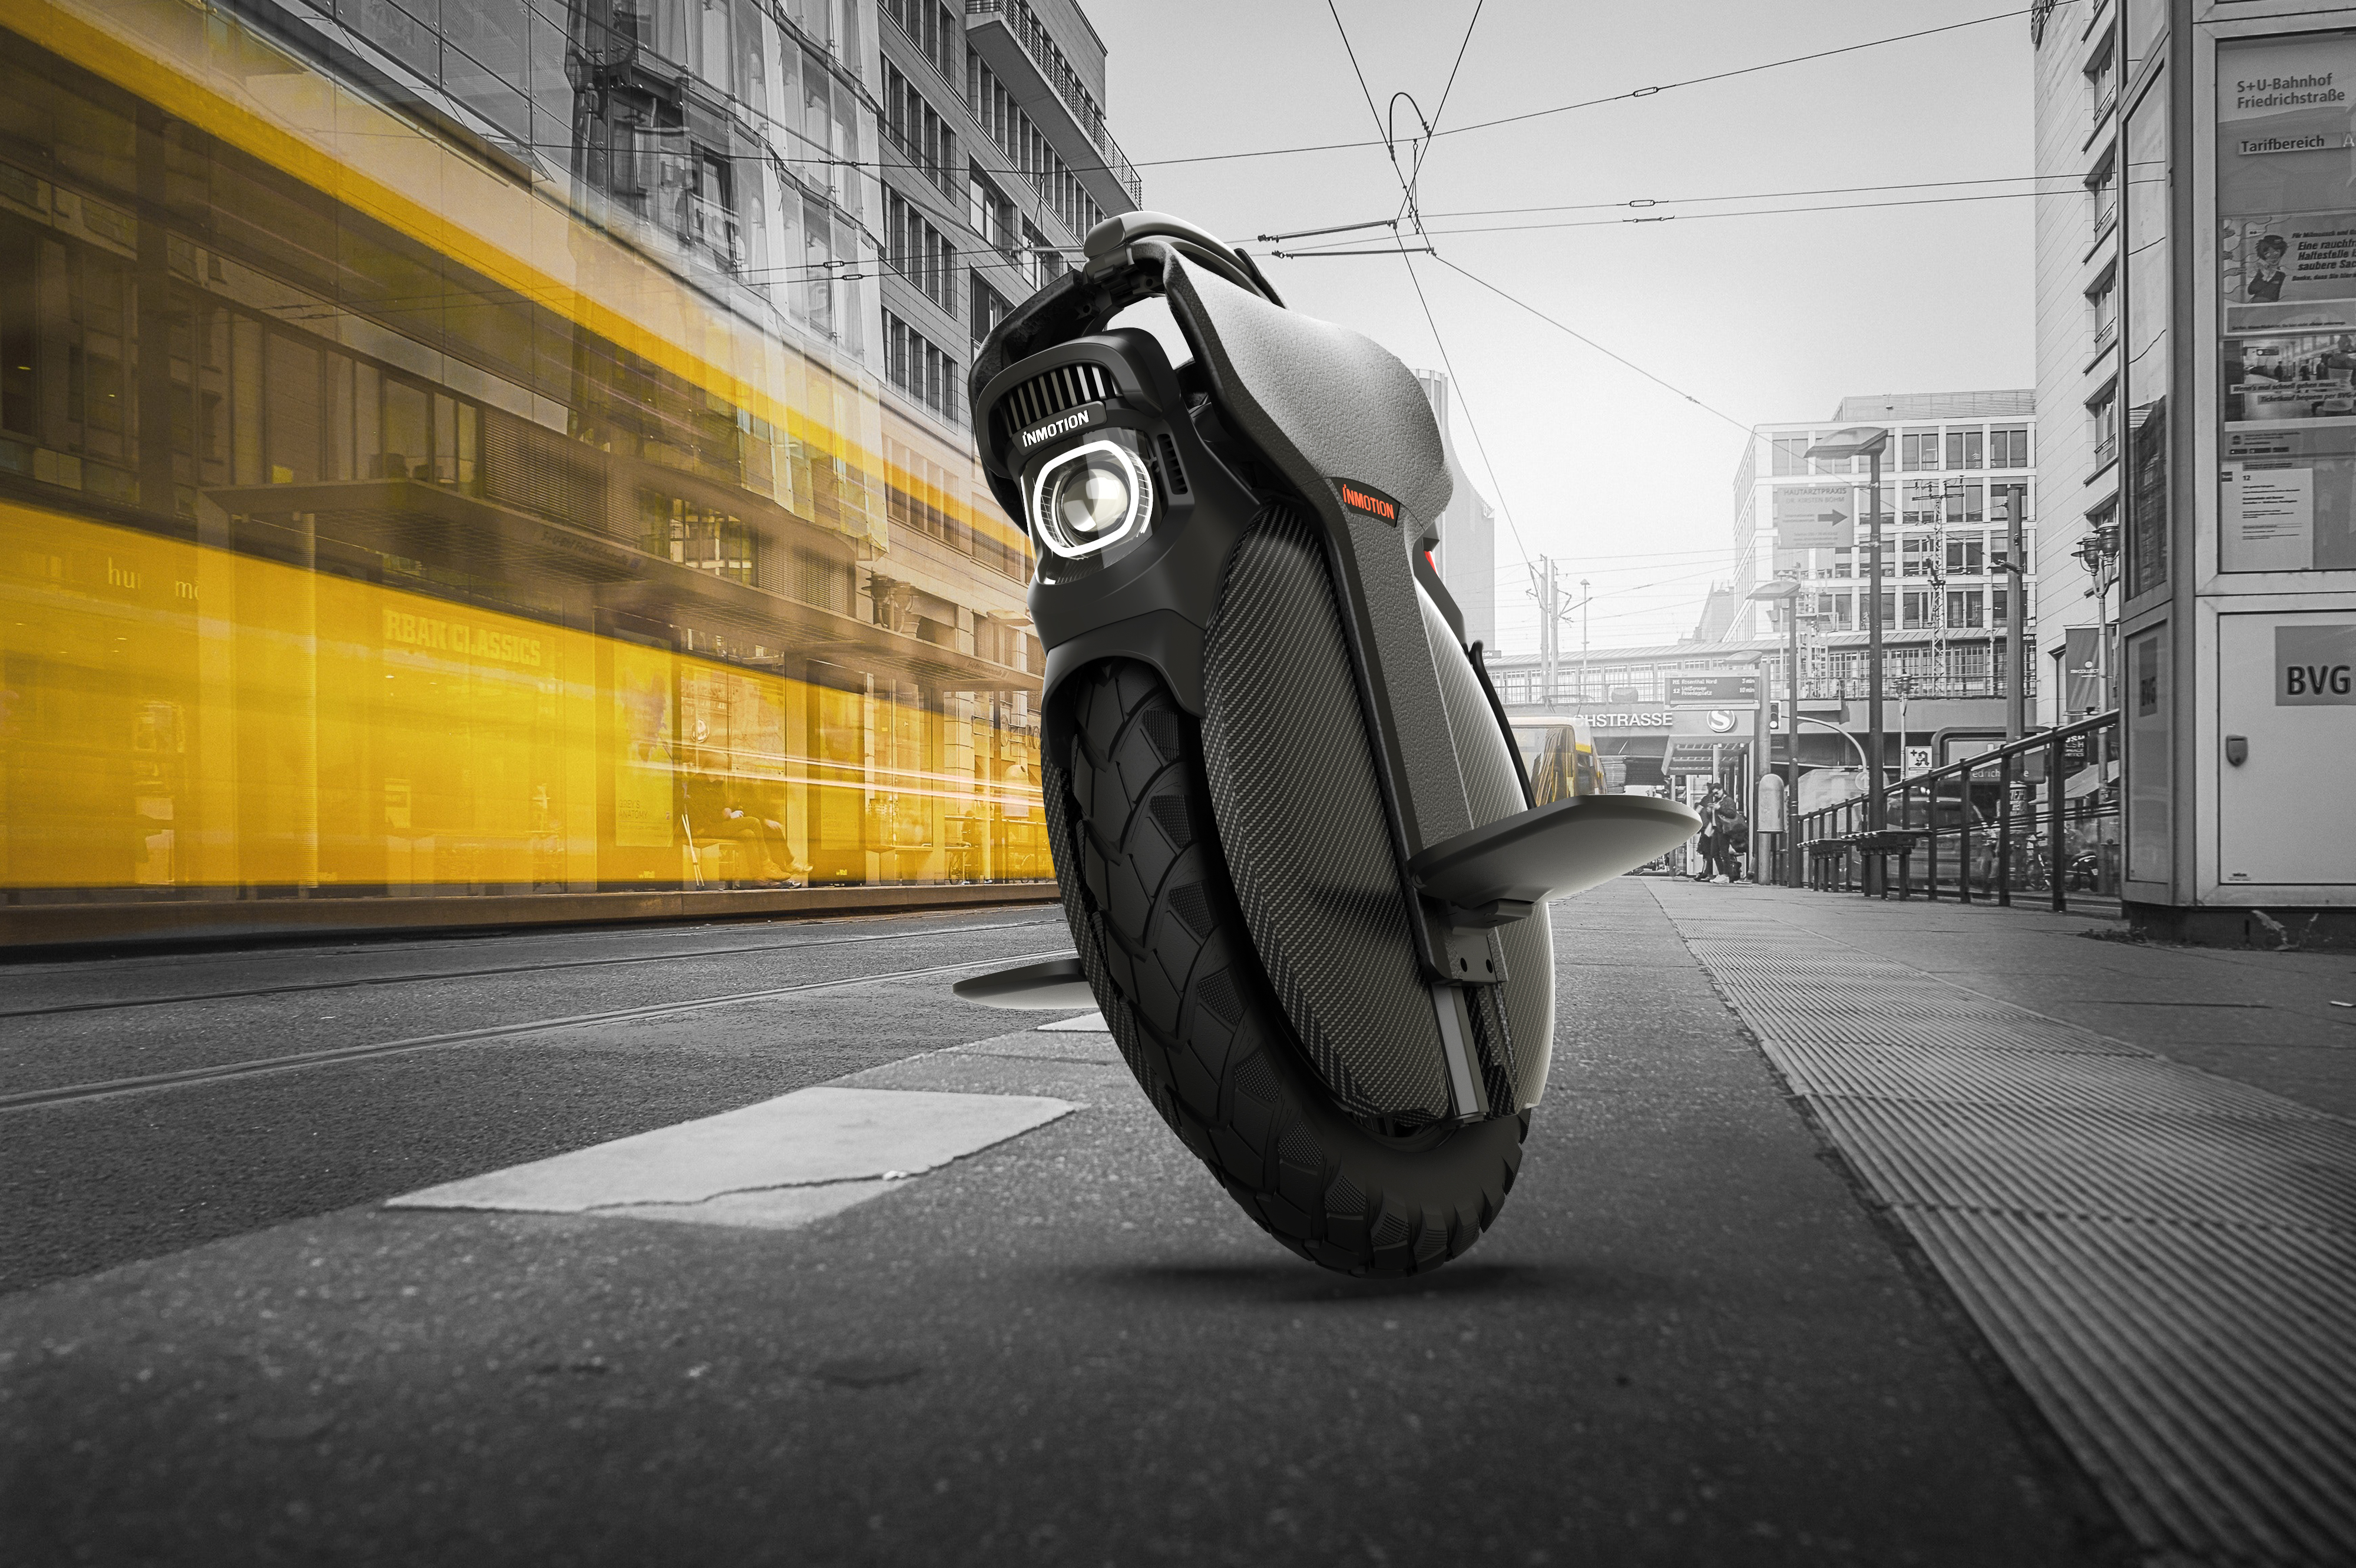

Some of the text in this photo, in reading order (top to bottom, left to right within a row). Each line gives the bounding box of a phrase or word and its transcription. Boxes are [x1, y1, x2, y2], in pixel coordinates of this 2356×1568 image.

[2237, 72, 2332, 92] S+U-Bahnhof
[2238, 88, 2345, 109] Friedrichstraße
[2241, 135, 2325, 152] Tarifbereich
[2297, 238, 2356, 250] Eine rauchfr
[2297, 249, 2349, 260] Haltestelle
[2297, 262, 2337, 270] saubere
[383, 610, 541, 667] RBAN CLASSICS
[2286, 665, 2351, 696] BVG
